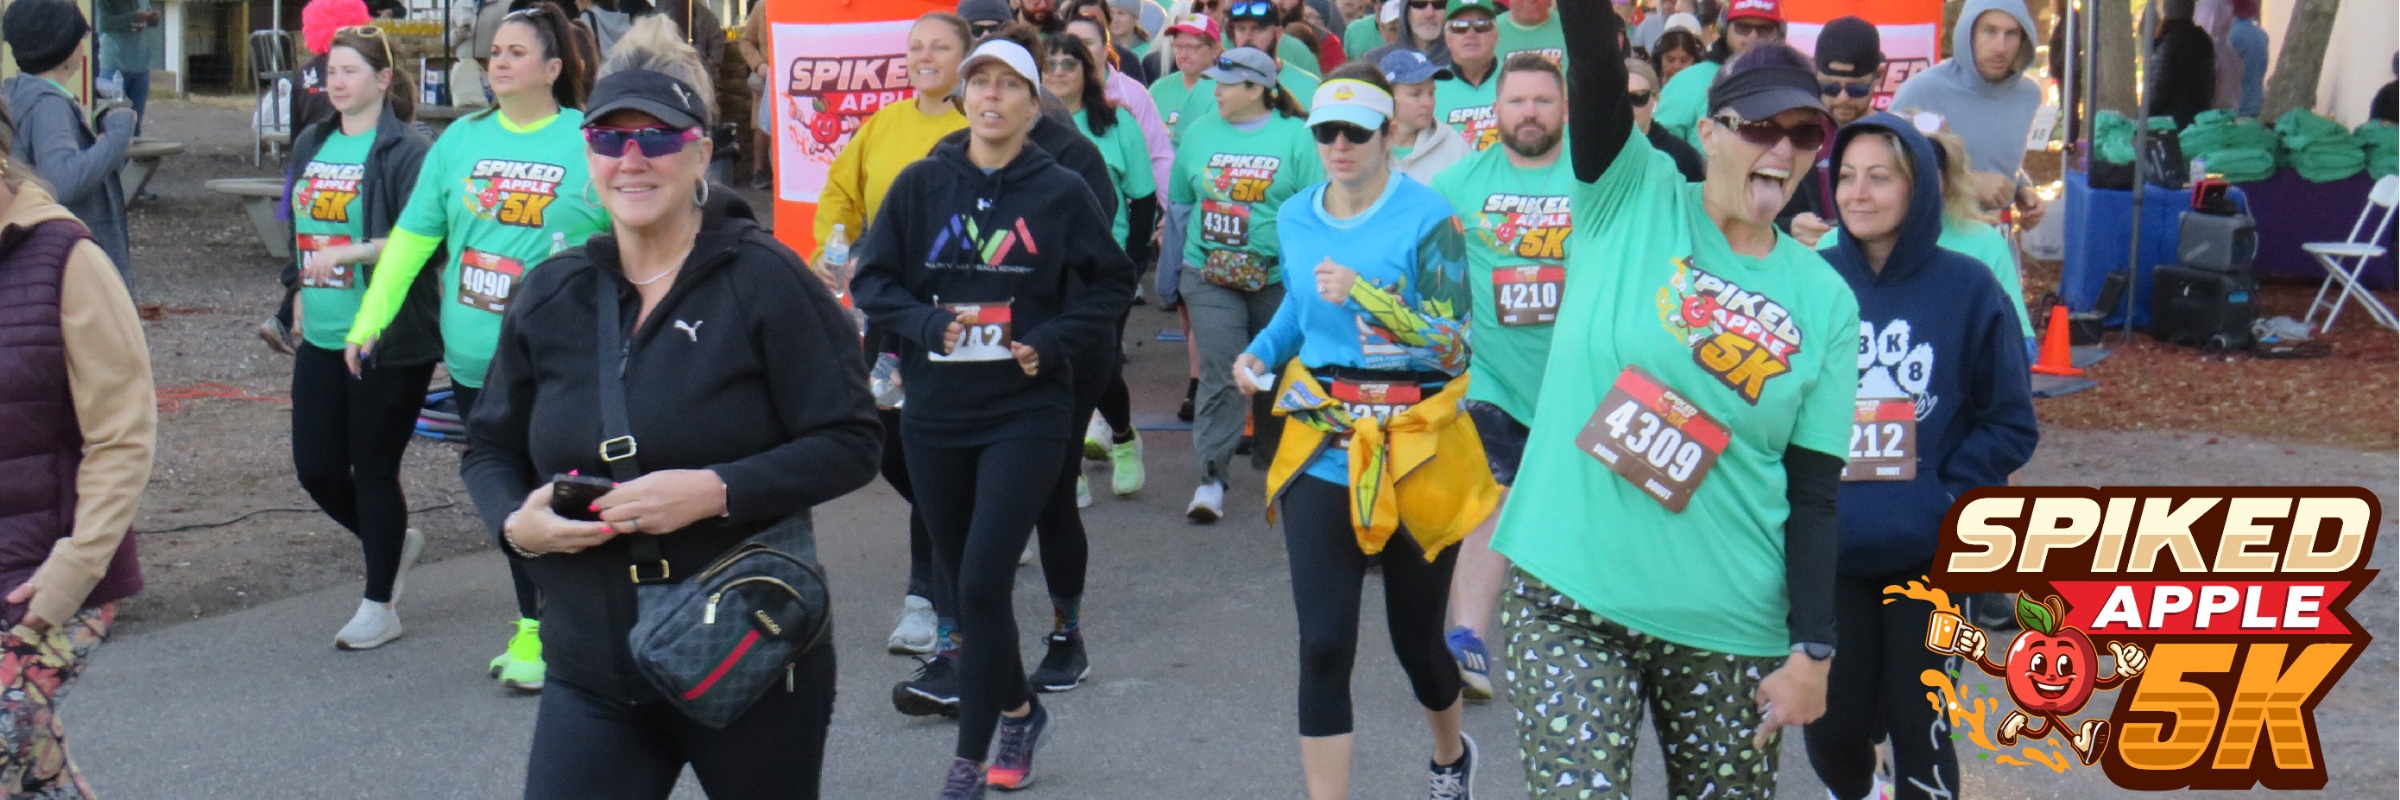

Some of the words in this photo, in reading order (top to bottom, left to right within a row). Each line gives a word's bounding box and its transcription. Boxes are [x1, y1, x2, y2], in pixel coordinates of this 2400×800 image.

[1449, 106, 1498, 123] SPIK
[472, 160, 565, 182] SPIKED
[1209, 153, 1280, 170] SPIKED
[1230, 169, 1269, 179] APPLE
[499, 179, 552, 192] APPLE
[1232, 178, 1271, 201] 5K
[311, 191, 356, 220] 5K
[500, 192, 555, 225] 5K
[1204, 211, 1240, 235] 4311
[1519, 227, 1573, 258] 5K
[463, 265, 511, 299] 4090
[1500, 282, 1557, 309] 4210
[1693, 268, 1800, 345] PIKED
[1712, 308, 1786, 356] APPLE
[1700, 331, 1786, 399] 5K
[1604, 400, 1702, 482] 4309
